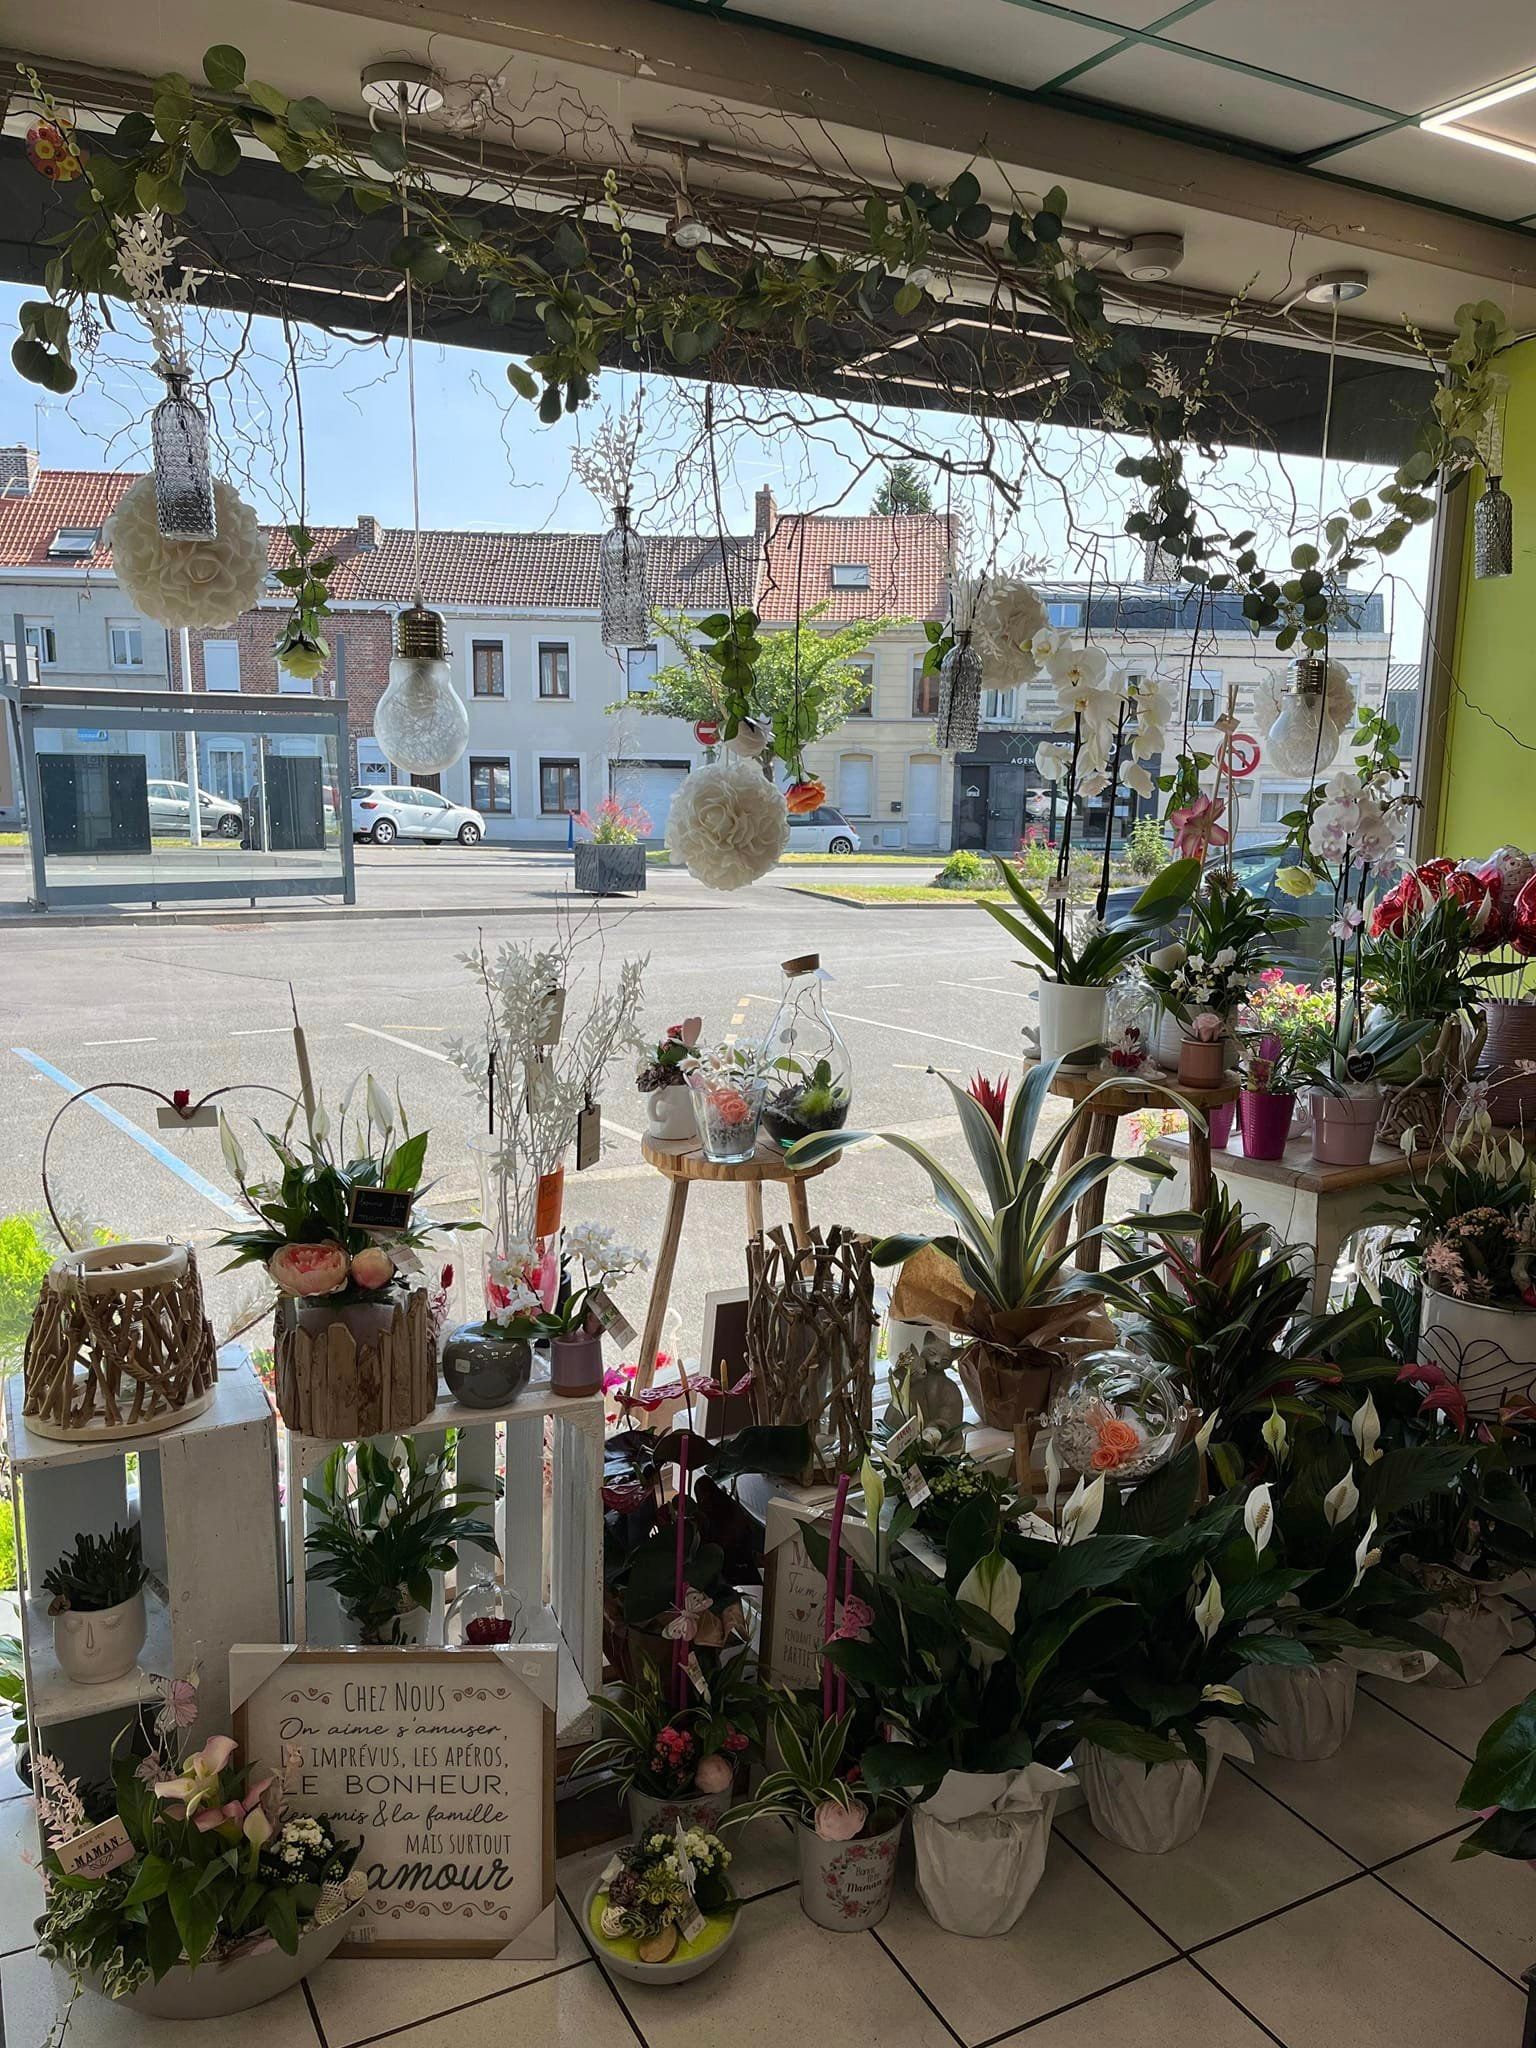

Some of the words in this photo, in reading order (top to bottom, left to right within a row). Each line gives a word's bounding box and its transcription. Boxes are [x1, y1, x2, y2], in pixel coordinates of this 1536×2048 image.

[1010, 757, 1035, 765] AGEN
[280, 1717, 320, 1740] On
[327, 1723, 389, 1736] aime
[396, 1716, 508, 1741] s'amuser,
[280, 1744, 305, 1768] LS
[311, 1743, 406, 1769] IMPRÉVUS,
[414, 1746, 438, 1767] LES
[444, 1743, 509, 1769] APÉROS,
[346, 1774, 508, 1797] BONHEUR,
[372, 1800, 388, 1827] &
[391, 1803, 420, 1823] la
[426, 1803, 508, 1831] famille
[74, 1836, 120, 1868] MAMAN
[406, 1834, 443, 1855] MAIS
[449, 1834, 511, 1855] SURTOUT
